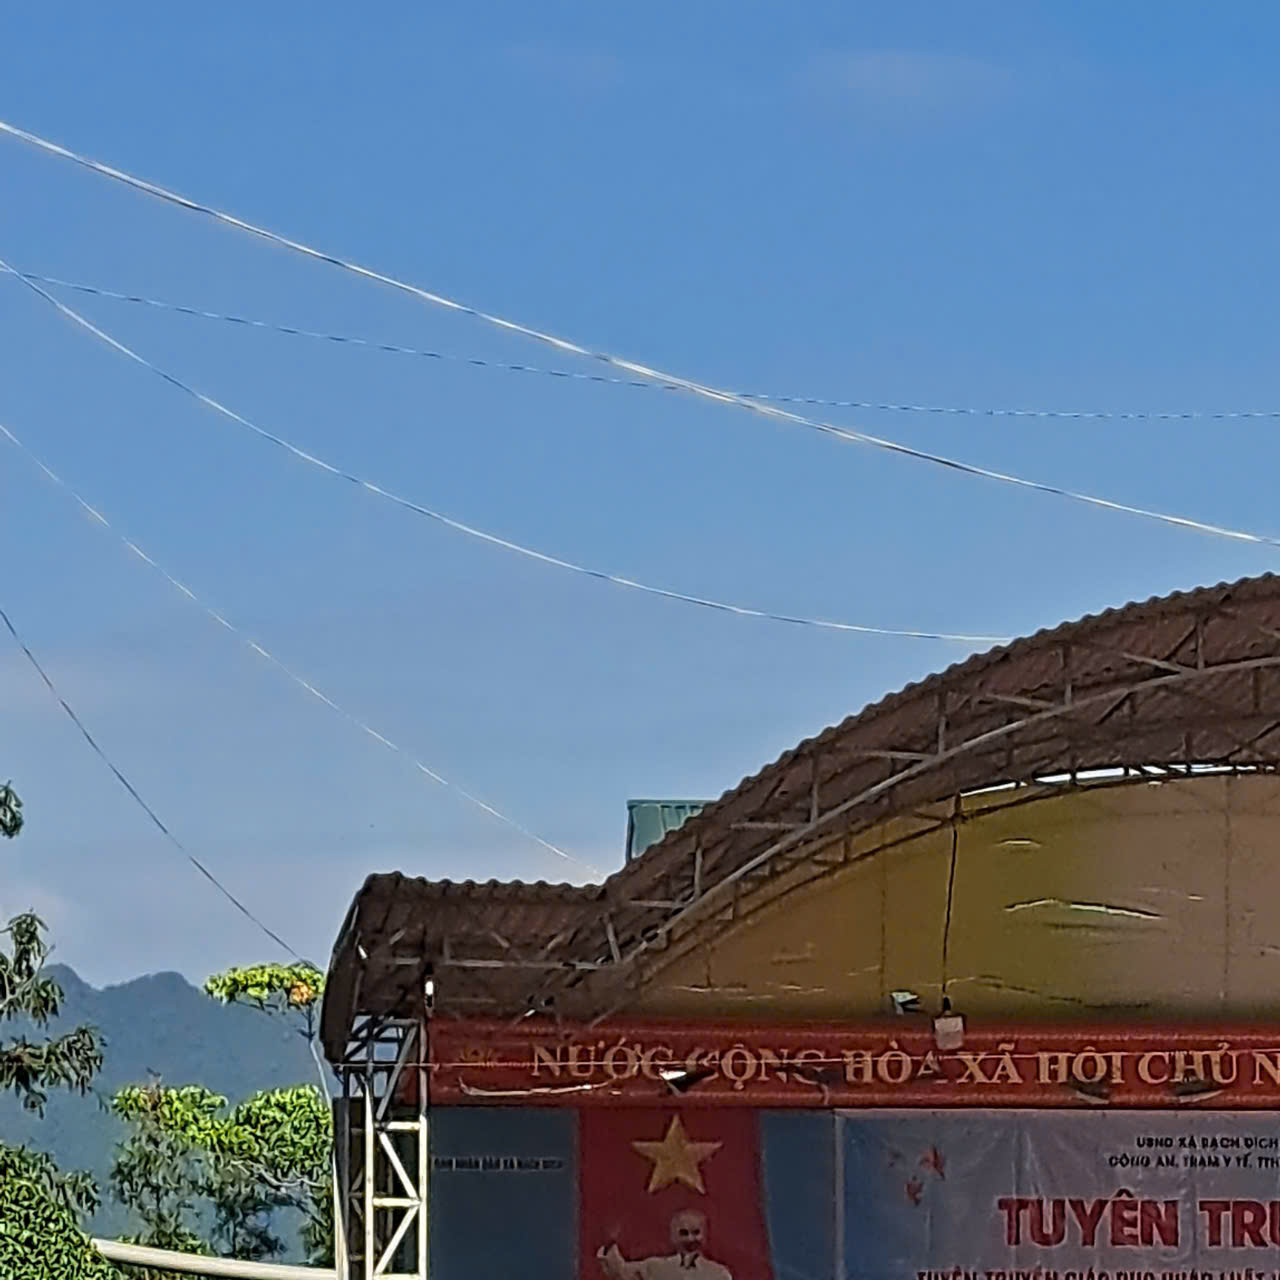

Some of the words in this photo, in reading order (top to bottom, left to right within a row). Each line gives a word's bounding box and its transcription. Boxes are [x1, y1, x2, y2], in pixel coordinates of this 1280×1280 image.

[531, 1038, 674, 1079] NƯỚC
[956, 1042, 1023, 1084] XÃ
[1137, 1042, 1239, 1085] CHỦ
[997, 1188, 1180, 1248] TUYÊN
